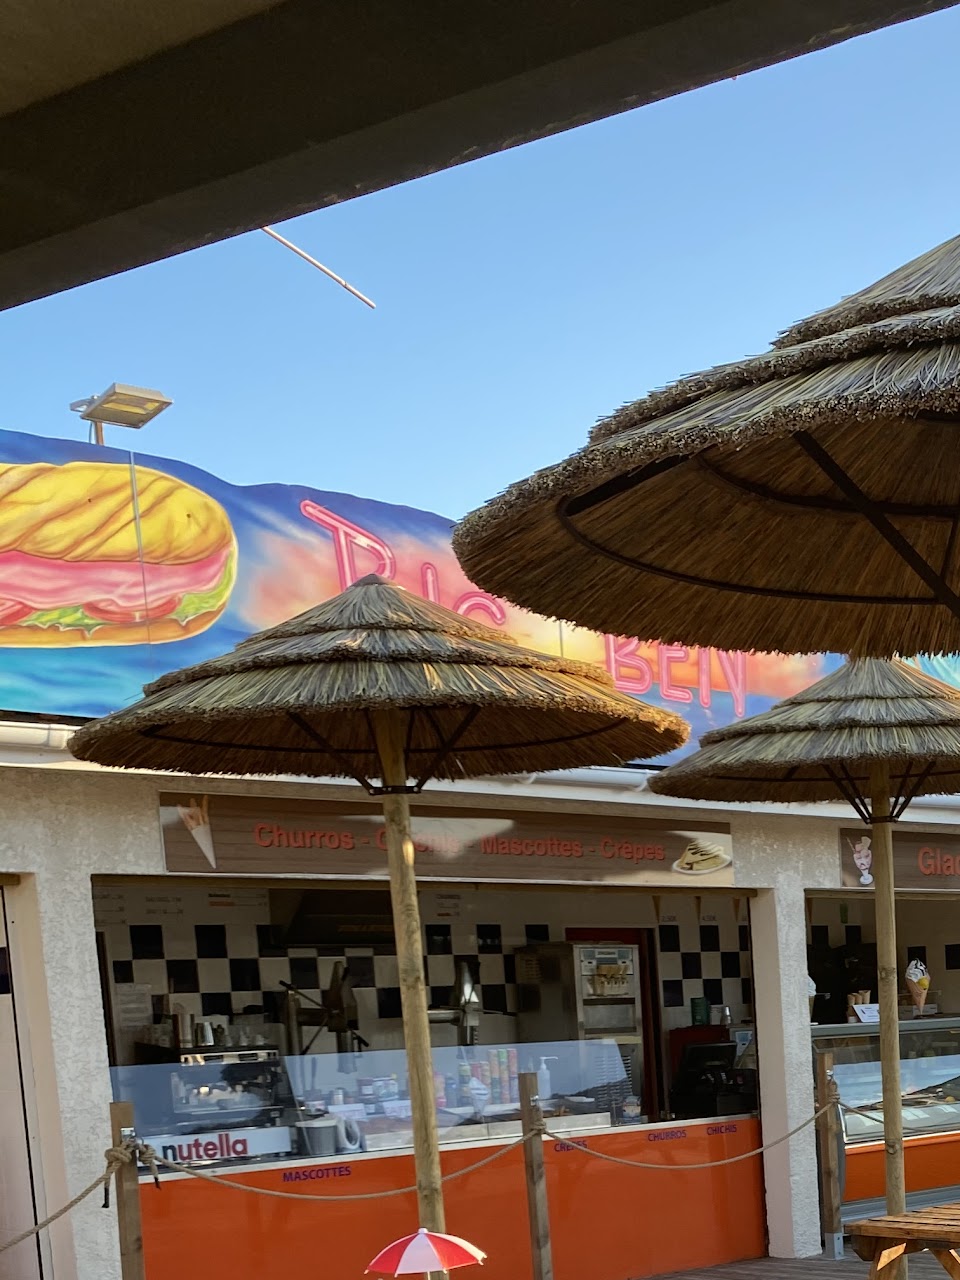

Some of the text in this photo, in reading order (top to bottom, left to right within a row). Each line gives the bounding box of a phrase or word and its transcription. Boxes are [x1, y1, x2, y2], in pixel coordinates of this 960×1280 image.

[254, 823, 355, 849] Churros
[481, 834, 584, 858] Mascottes
[600, 836, 665, 864] Crêpes
[647, 1129, 687, 1142] CHURROS
[706, 1124, 737, 1136] CHICHIS
[162, 1132, 248, 1162] nutella
[282, 1165, 352, 1182] MASCOTTES
